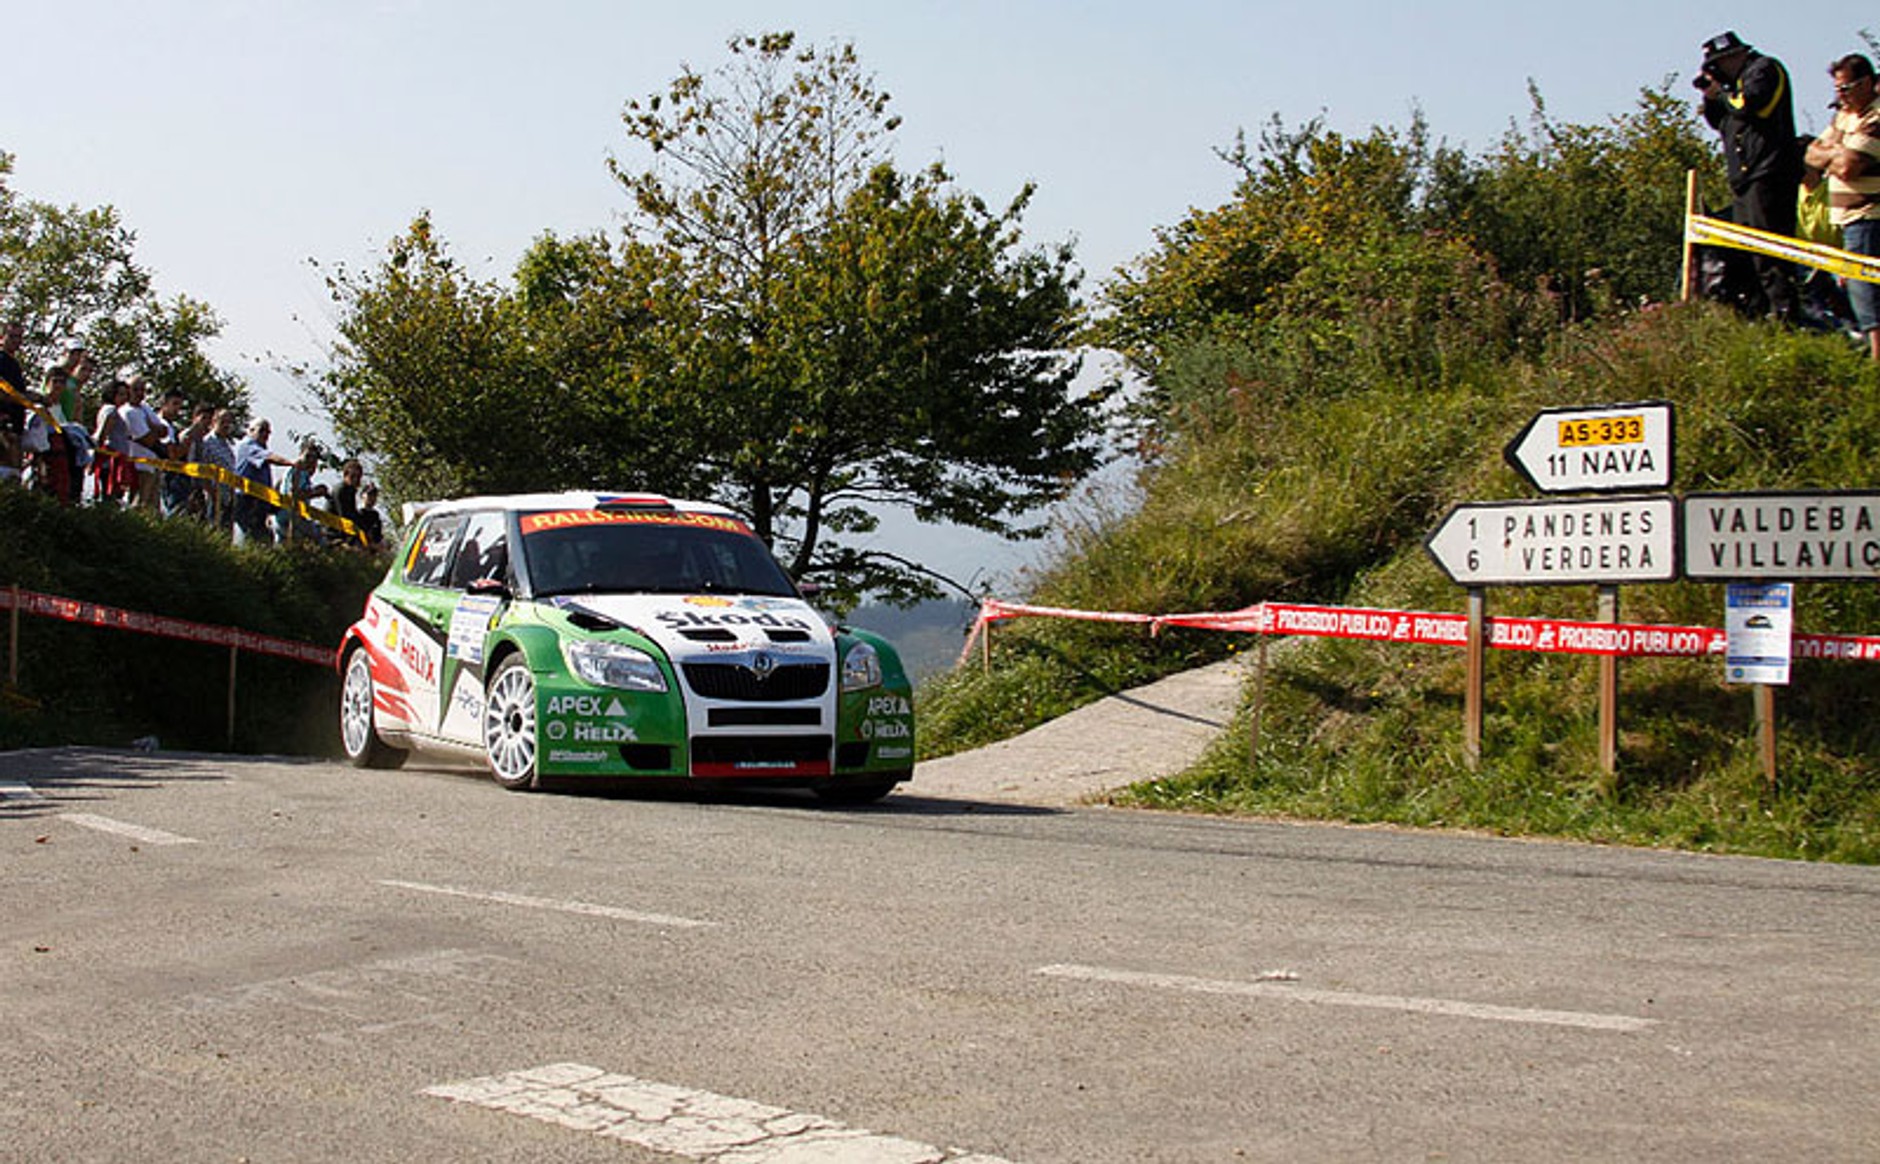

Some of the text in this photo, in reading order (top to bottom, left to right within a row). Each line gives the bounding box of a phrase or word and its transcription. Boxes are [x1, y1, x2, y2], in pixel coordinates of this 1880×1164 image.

[1562, 420, 1640, 443] AS-333
[1547, 449, 1655, 476] 11 NAVA
[1467, 510, 1654, 540] 1 PANDENES
[1709, 506, 1872, 533] VALDEBA
[1466, 544, 1654, 571] 6 VERDERA
[1278, 609, 1390, 637] PROHIBIDO PUBLICO
[1414, 618, 1468, 642] PROHIBID
[1558, 625, 1699, 654] PROHIBIDO PUBLICO
[401, 638, 436, 686] HELIX
[546, 696, 603, 717] APEX
[867, 696, 897, 715] APEX
[573, 721, 640, 741] HELIX
